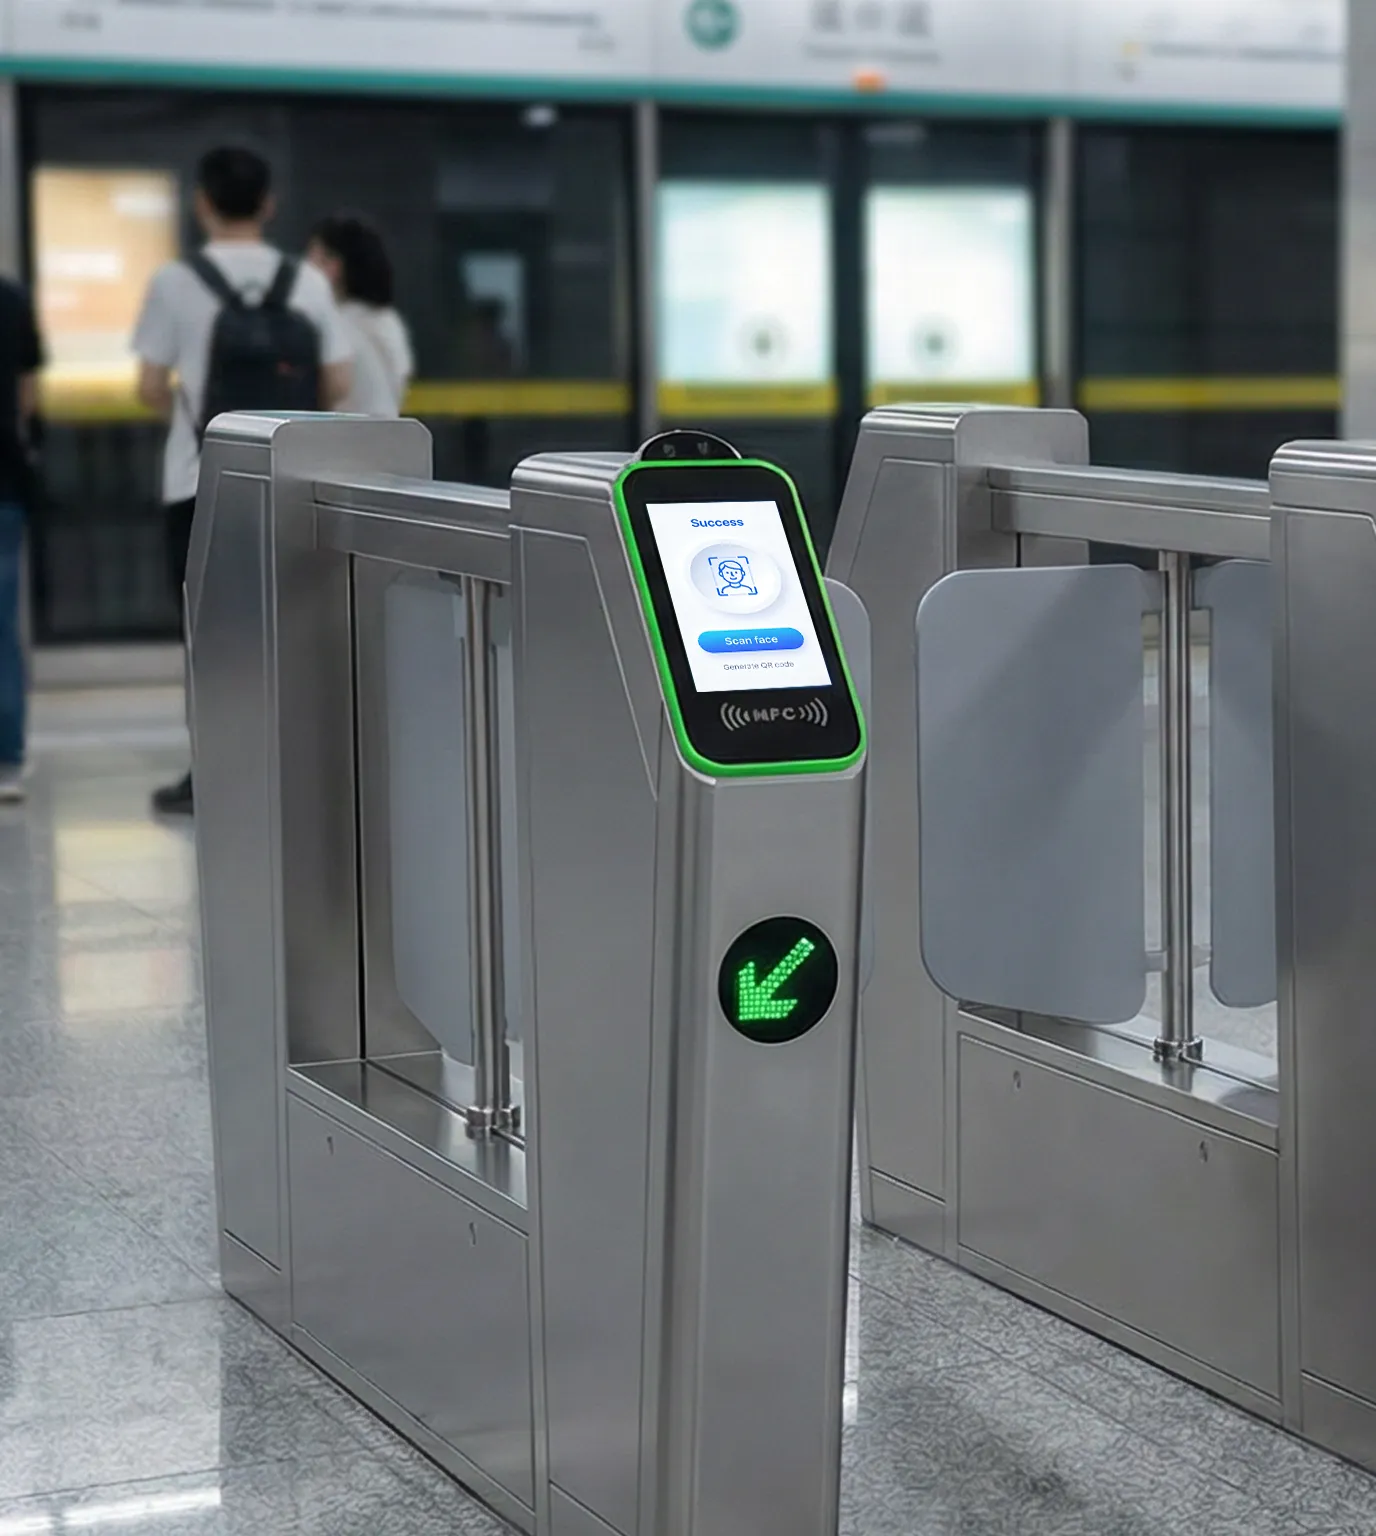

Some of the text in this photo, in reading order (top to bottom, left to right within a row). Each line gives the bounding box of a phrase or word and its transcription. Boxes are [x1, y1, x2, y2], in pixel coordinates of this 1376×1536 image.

[690, 518, 744, 528] Success
[724, 635, 779, 646] Scan face
[760, 661, 773, 669] QR
[774, 660, 795, 668] code
[753, 706, 796, 721] NFC
